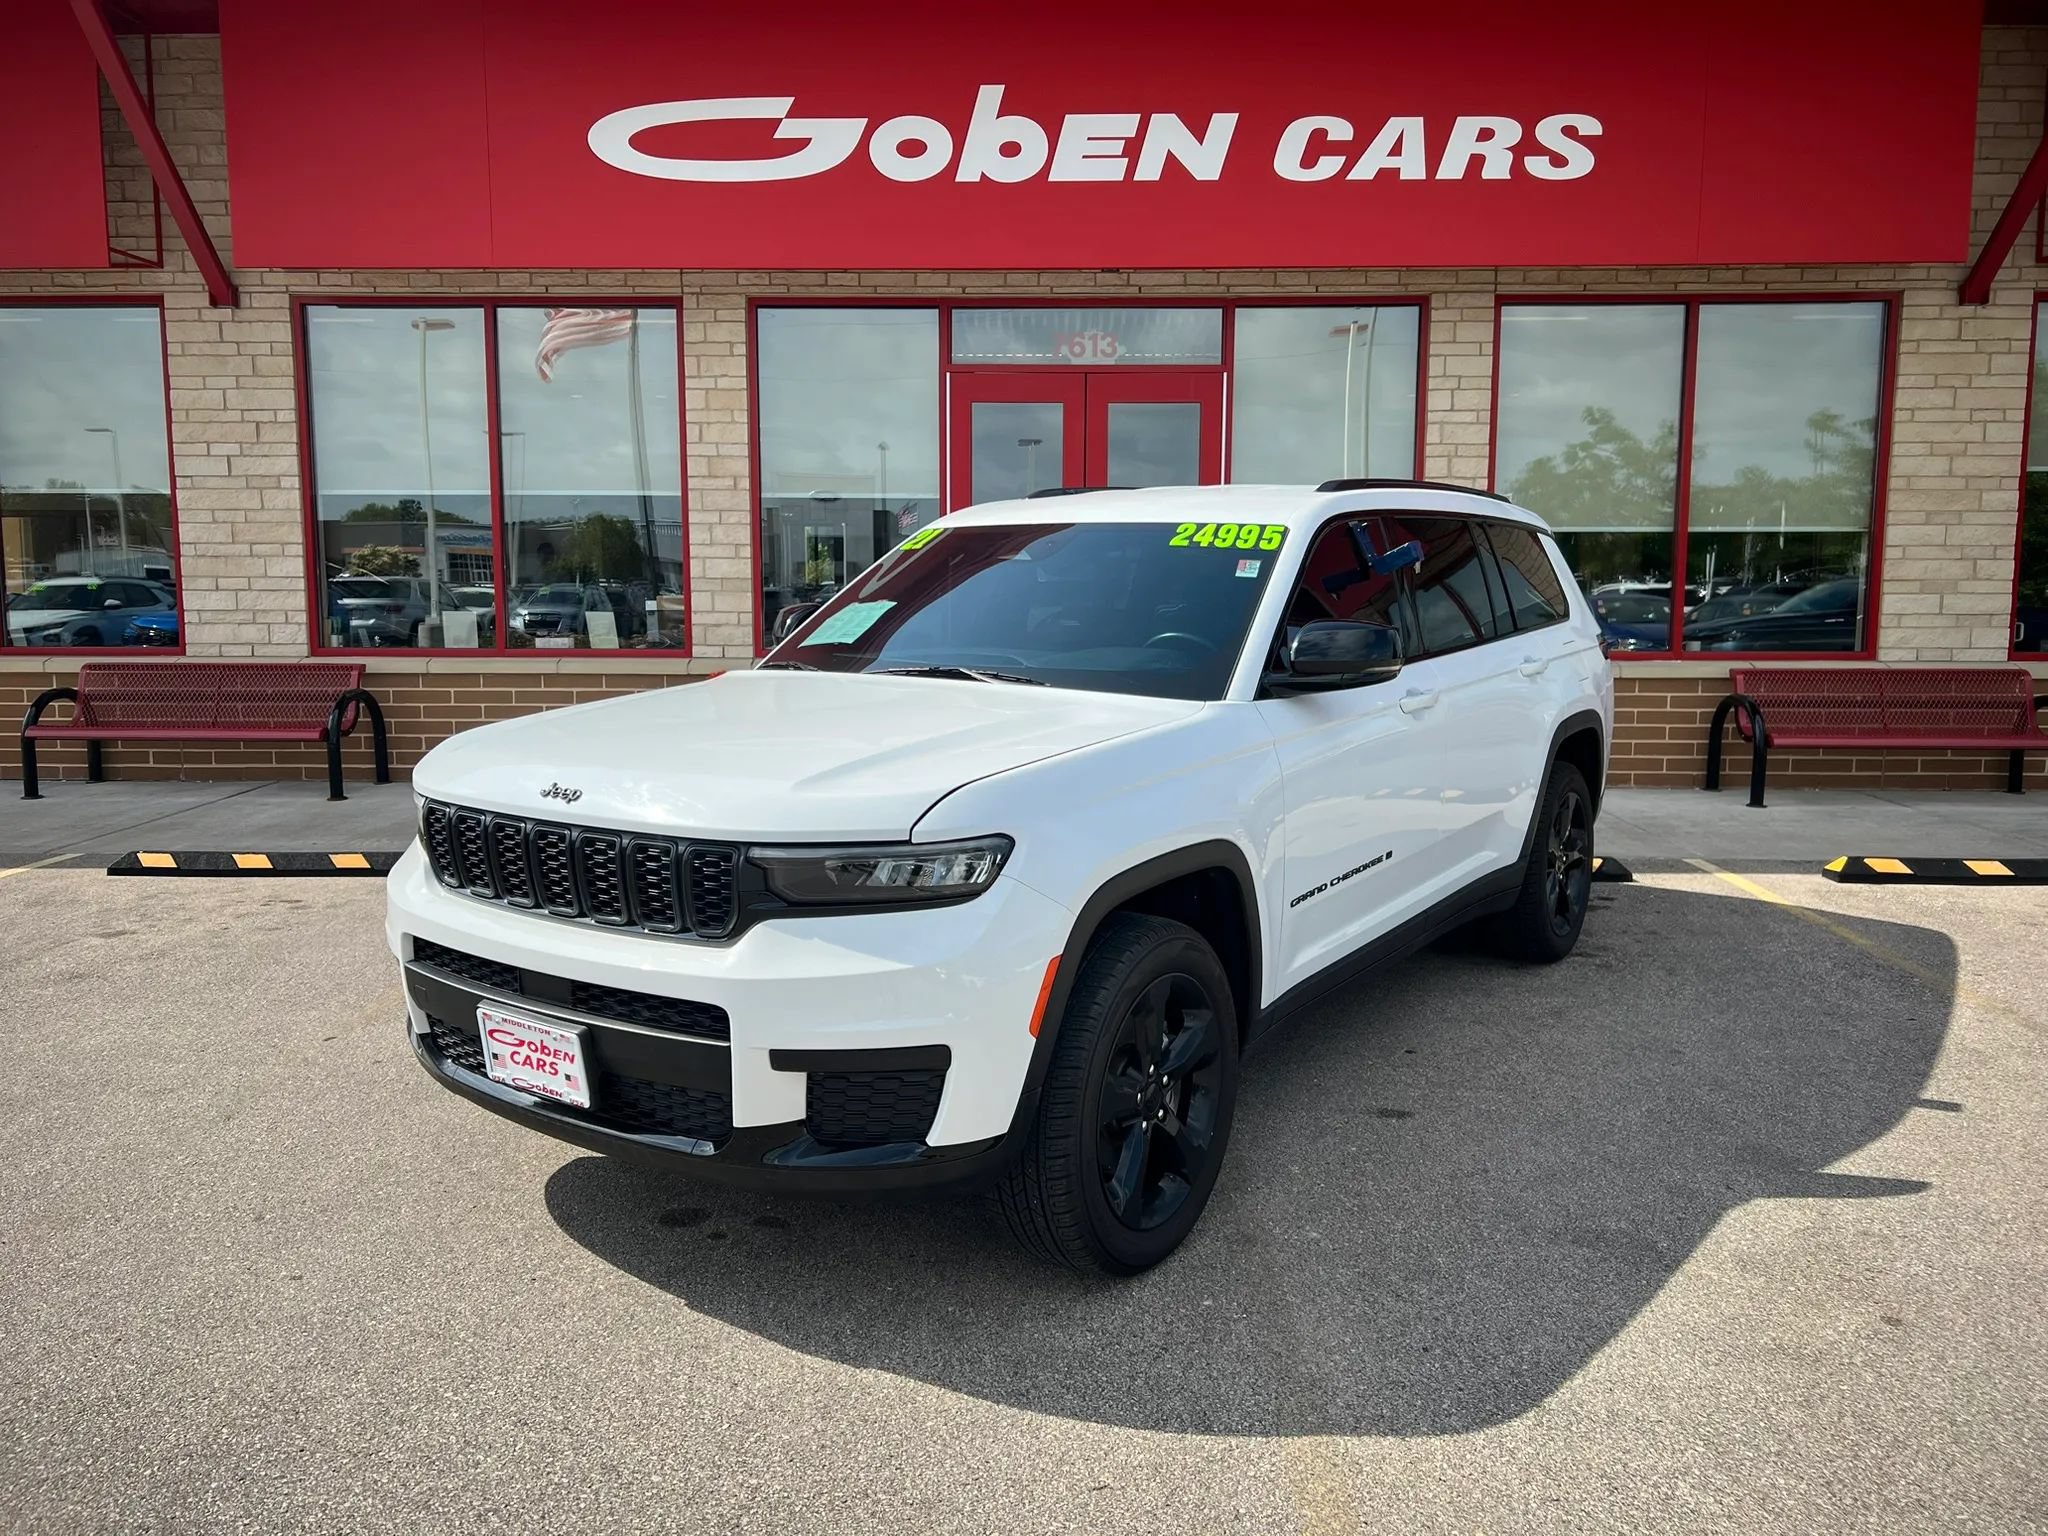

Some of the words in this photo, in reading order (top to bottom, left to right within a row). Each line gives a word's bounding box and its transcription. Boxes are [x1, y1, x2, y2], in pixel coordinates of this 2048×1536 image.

[1273, 113, 1603, 181] CARS
[1169, 523, 1285, 550] 24995
[540, 782, 583, 804] Jeep
[1290, 883, 1328, 908] GRAND
[1330, 854, 1384, 887] CHEROKEE
[501, 1017, 551, 1036] MIDDLETON
[510, 1050, 559, 1076] CARS
